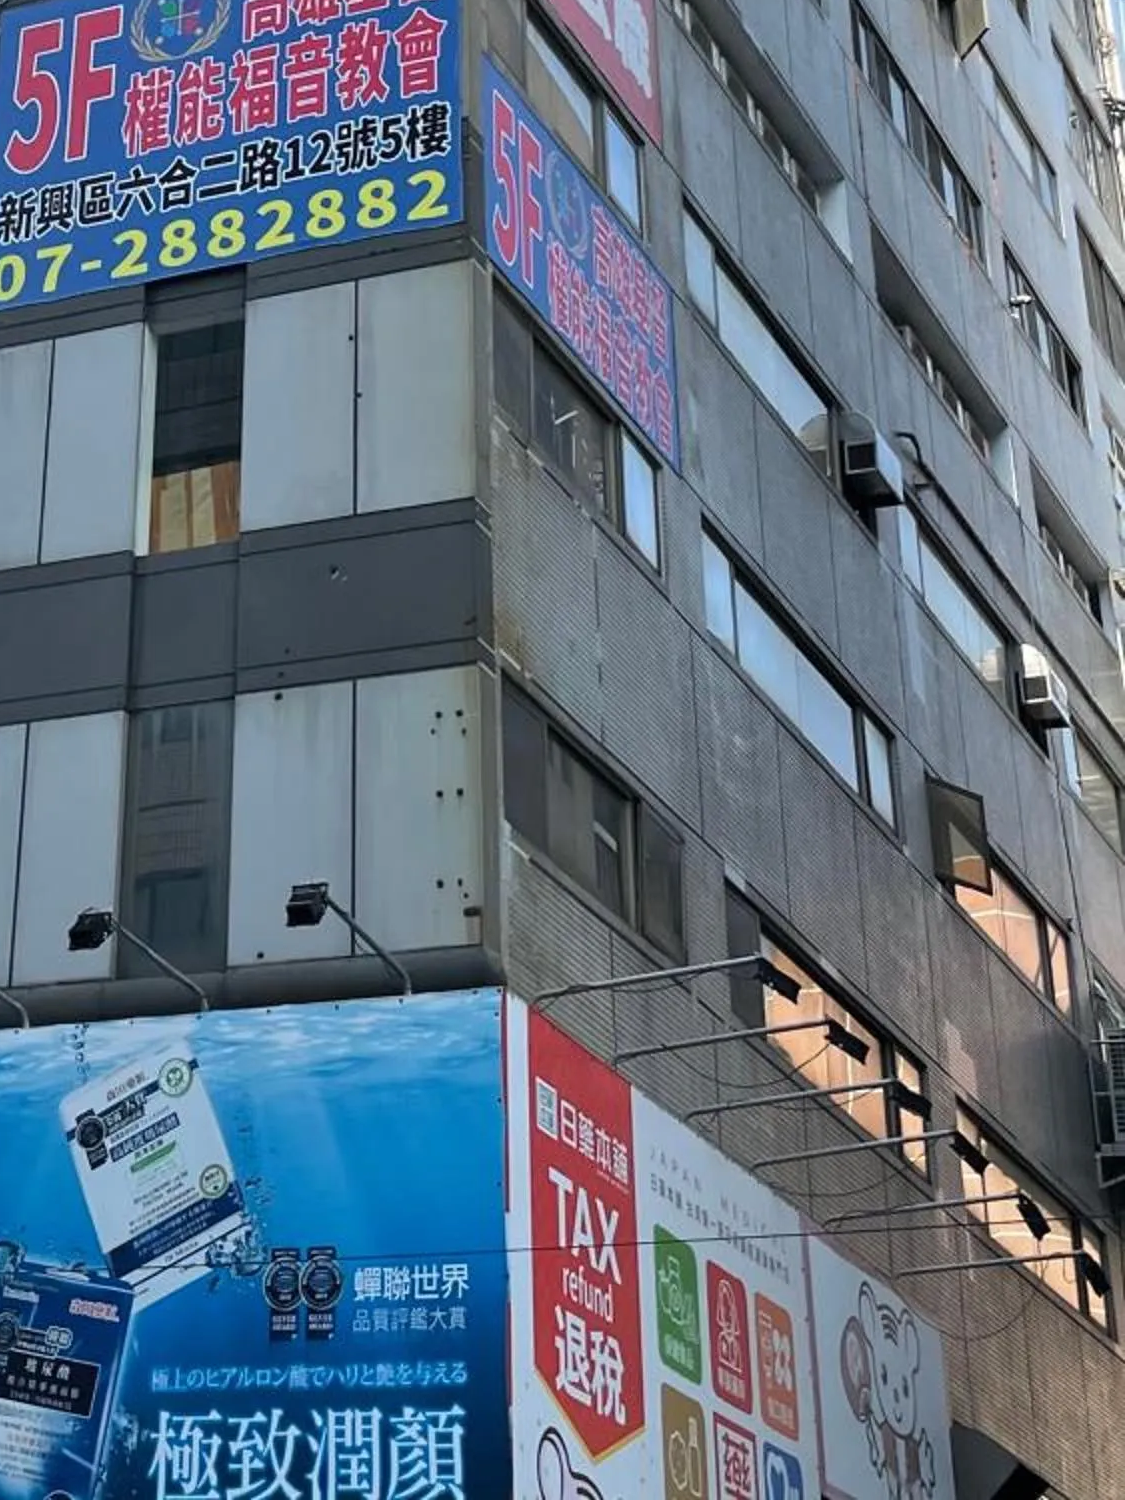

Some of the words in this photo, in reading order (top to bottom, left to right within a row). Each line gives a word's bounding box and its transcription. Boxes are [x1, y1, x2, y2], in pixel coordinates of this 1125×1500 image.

[3, 3, 124, 174] 5F
[122, 8, 447, 160] 權能福音教會
[492, 89, 543, 289] 5F
[548, 1166, 623, 1285] TAX
[562, 1266, 614, 1324] refund
[555, 1305, 628, 1426] 退稅
